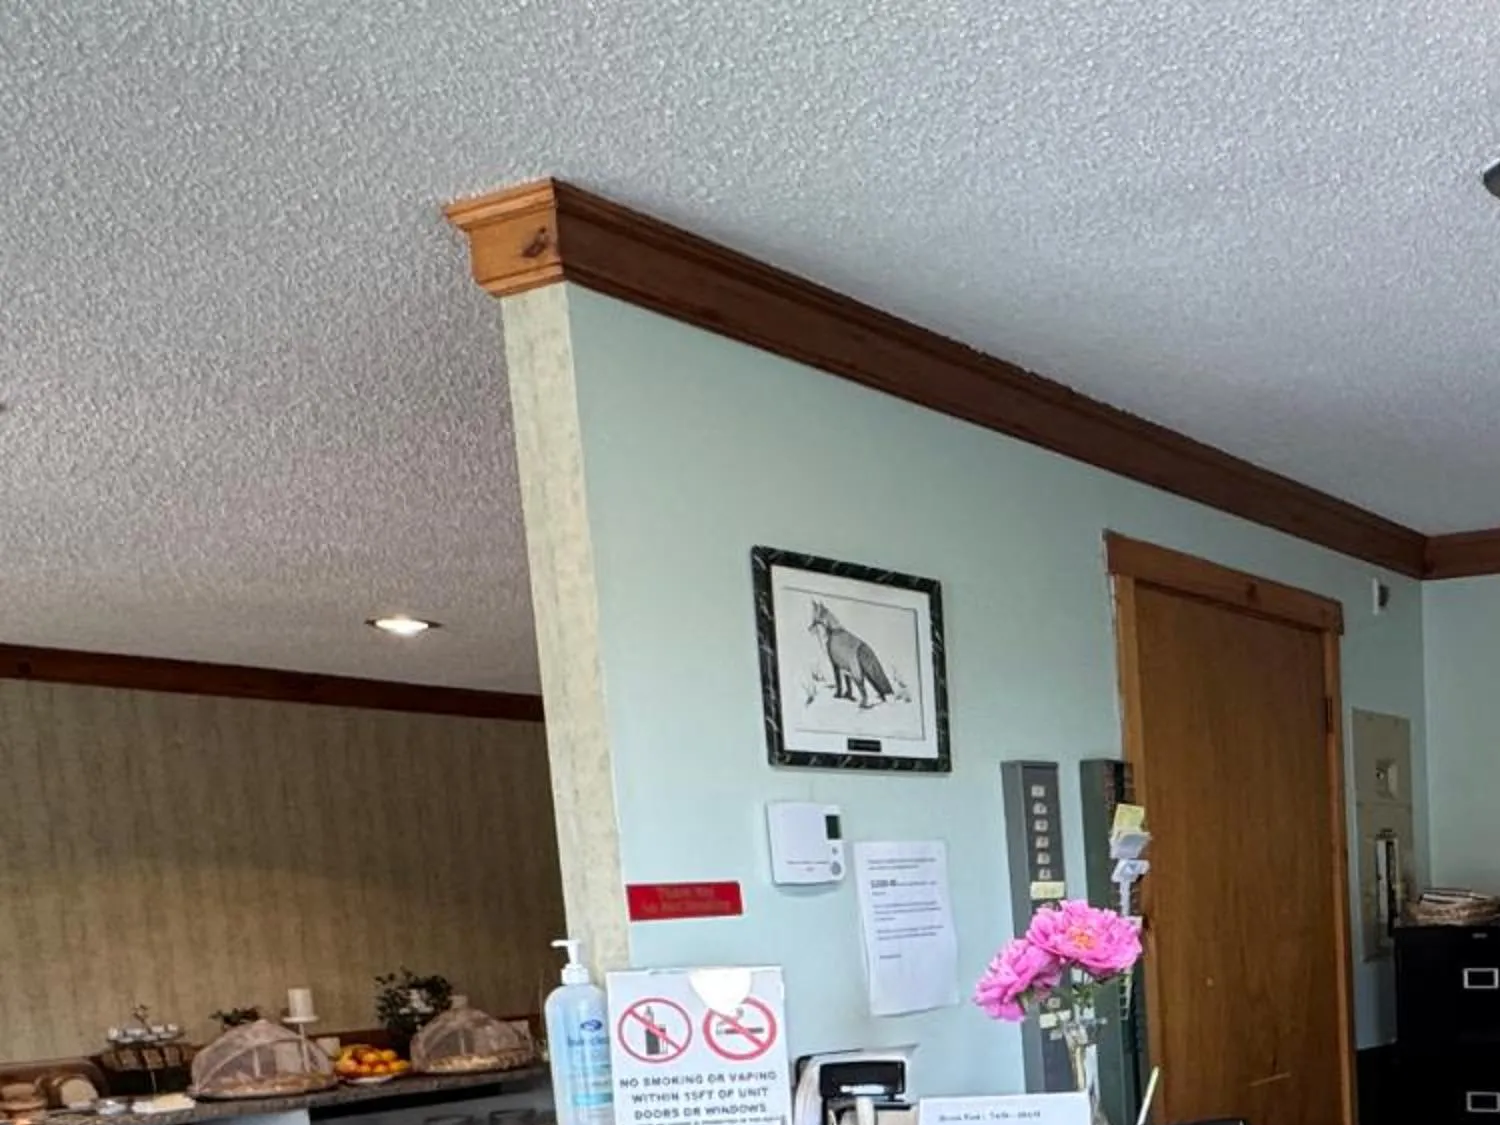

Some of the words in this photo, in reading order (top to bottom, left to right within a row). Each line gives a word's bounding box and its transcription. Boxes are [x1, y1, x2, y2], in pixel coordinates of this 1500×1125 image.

[619, 1076, 639, 1088] NO
[643, 1074, 703, 1086] SMOKING
[707, 1072, 725, 1084] OR
[729, 1070, 778, 1082] VAPING
[631, 1091, 680, 1104] WITHIN
[717, 1088, 734, 1100] OF
[737, 1086, 769, 1098] UNIT
[634, 1107, 680, 1120] DOORS
[683, 1105, 701, 1117] OR
[704, 1102, 767, 1116] WINDOWS
